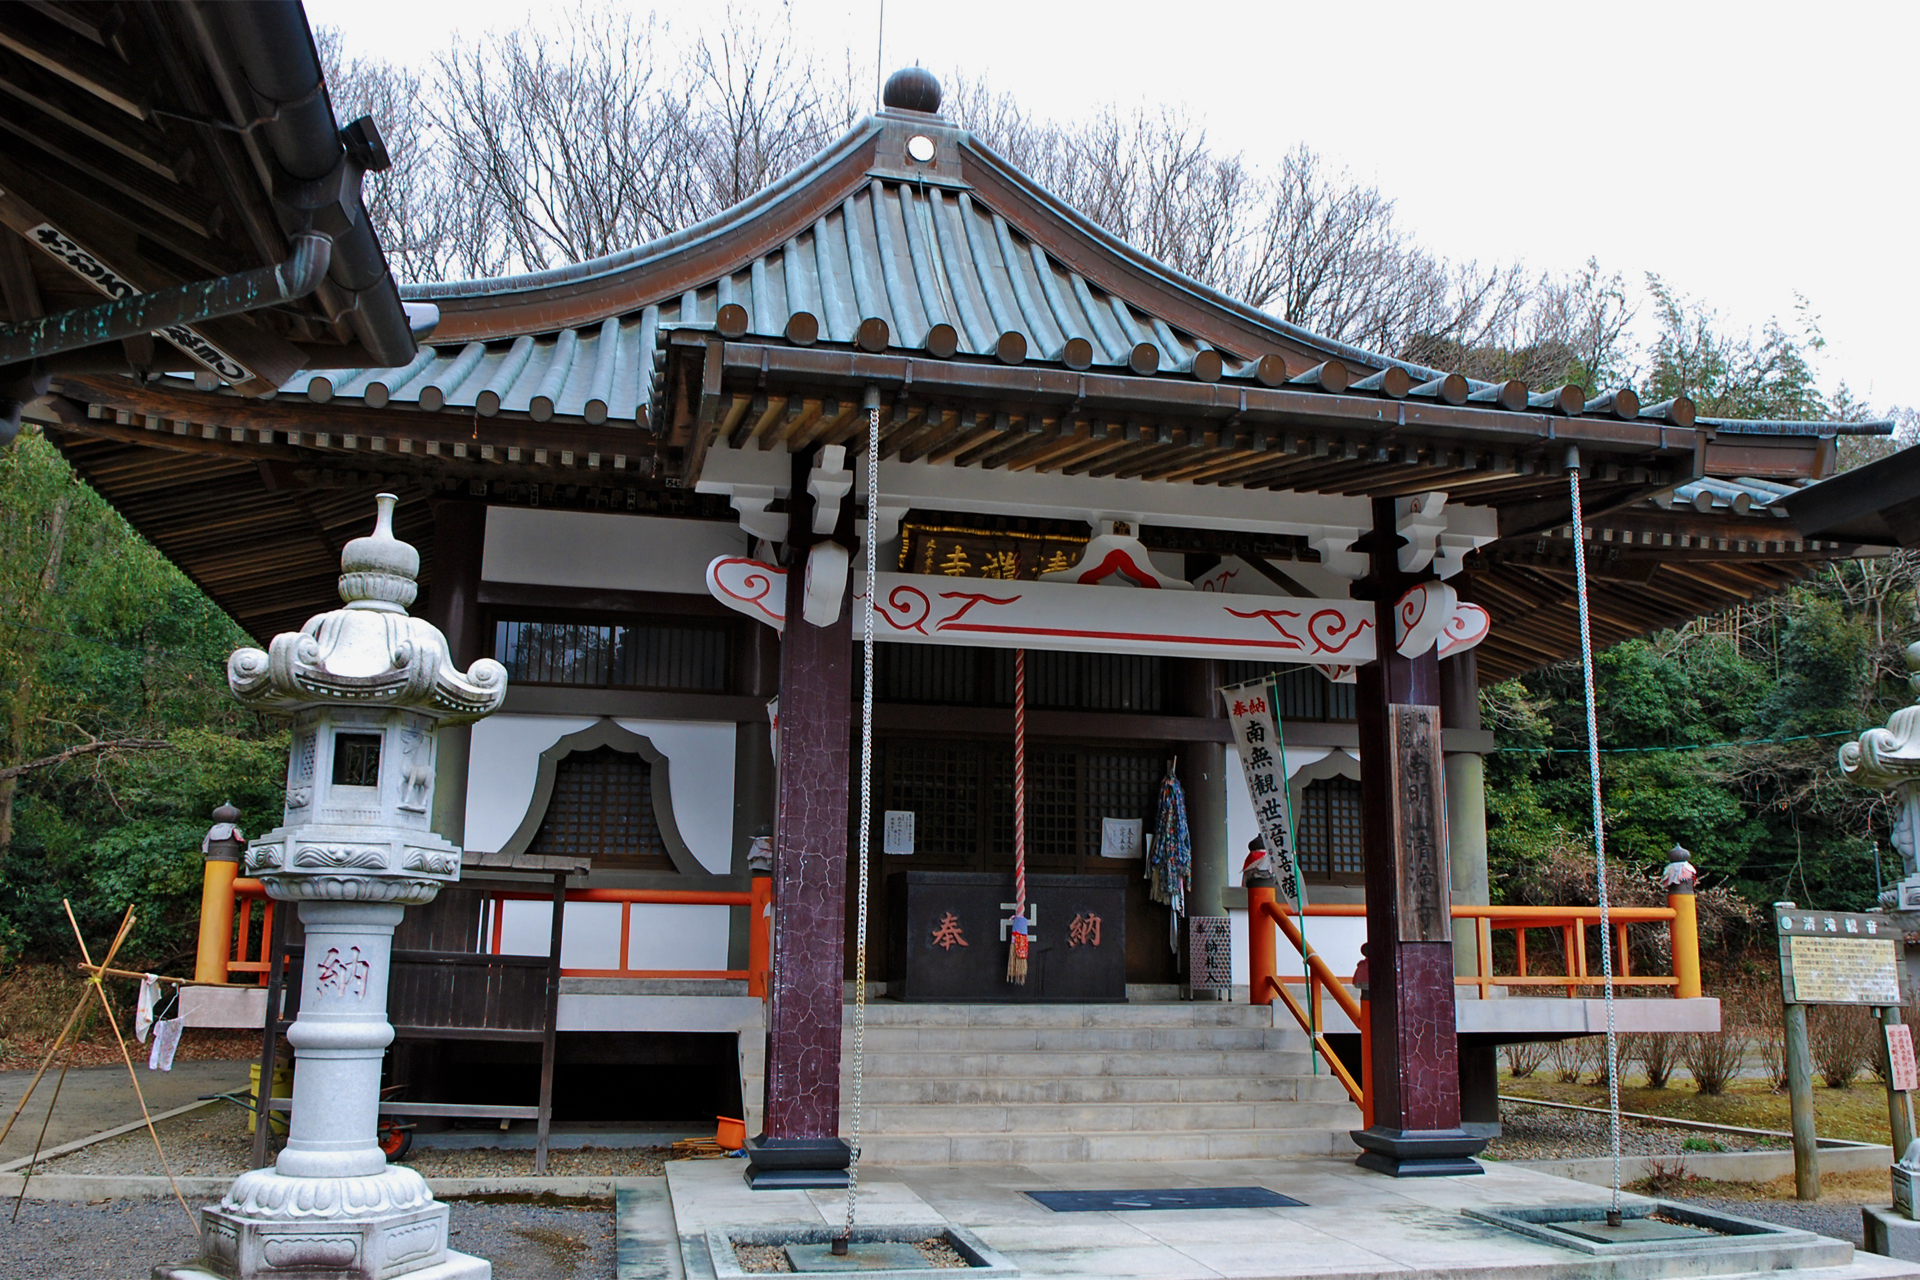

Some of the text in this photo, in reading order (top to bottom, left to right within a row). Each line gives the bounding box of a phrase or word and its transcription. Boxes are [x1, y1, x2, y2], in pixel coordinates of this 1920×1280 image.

[1232, 696, 1266, 719] 奉納
[1245, 720, 1299, 900] 南無観世音菩薩
[932, 911, 1103, 951] 奉 納
[1802, 916, 1878, 935] 清滝観音
[316, 945, 370, 1001] 納
[1204, 939, 1220, 984] 納札入
